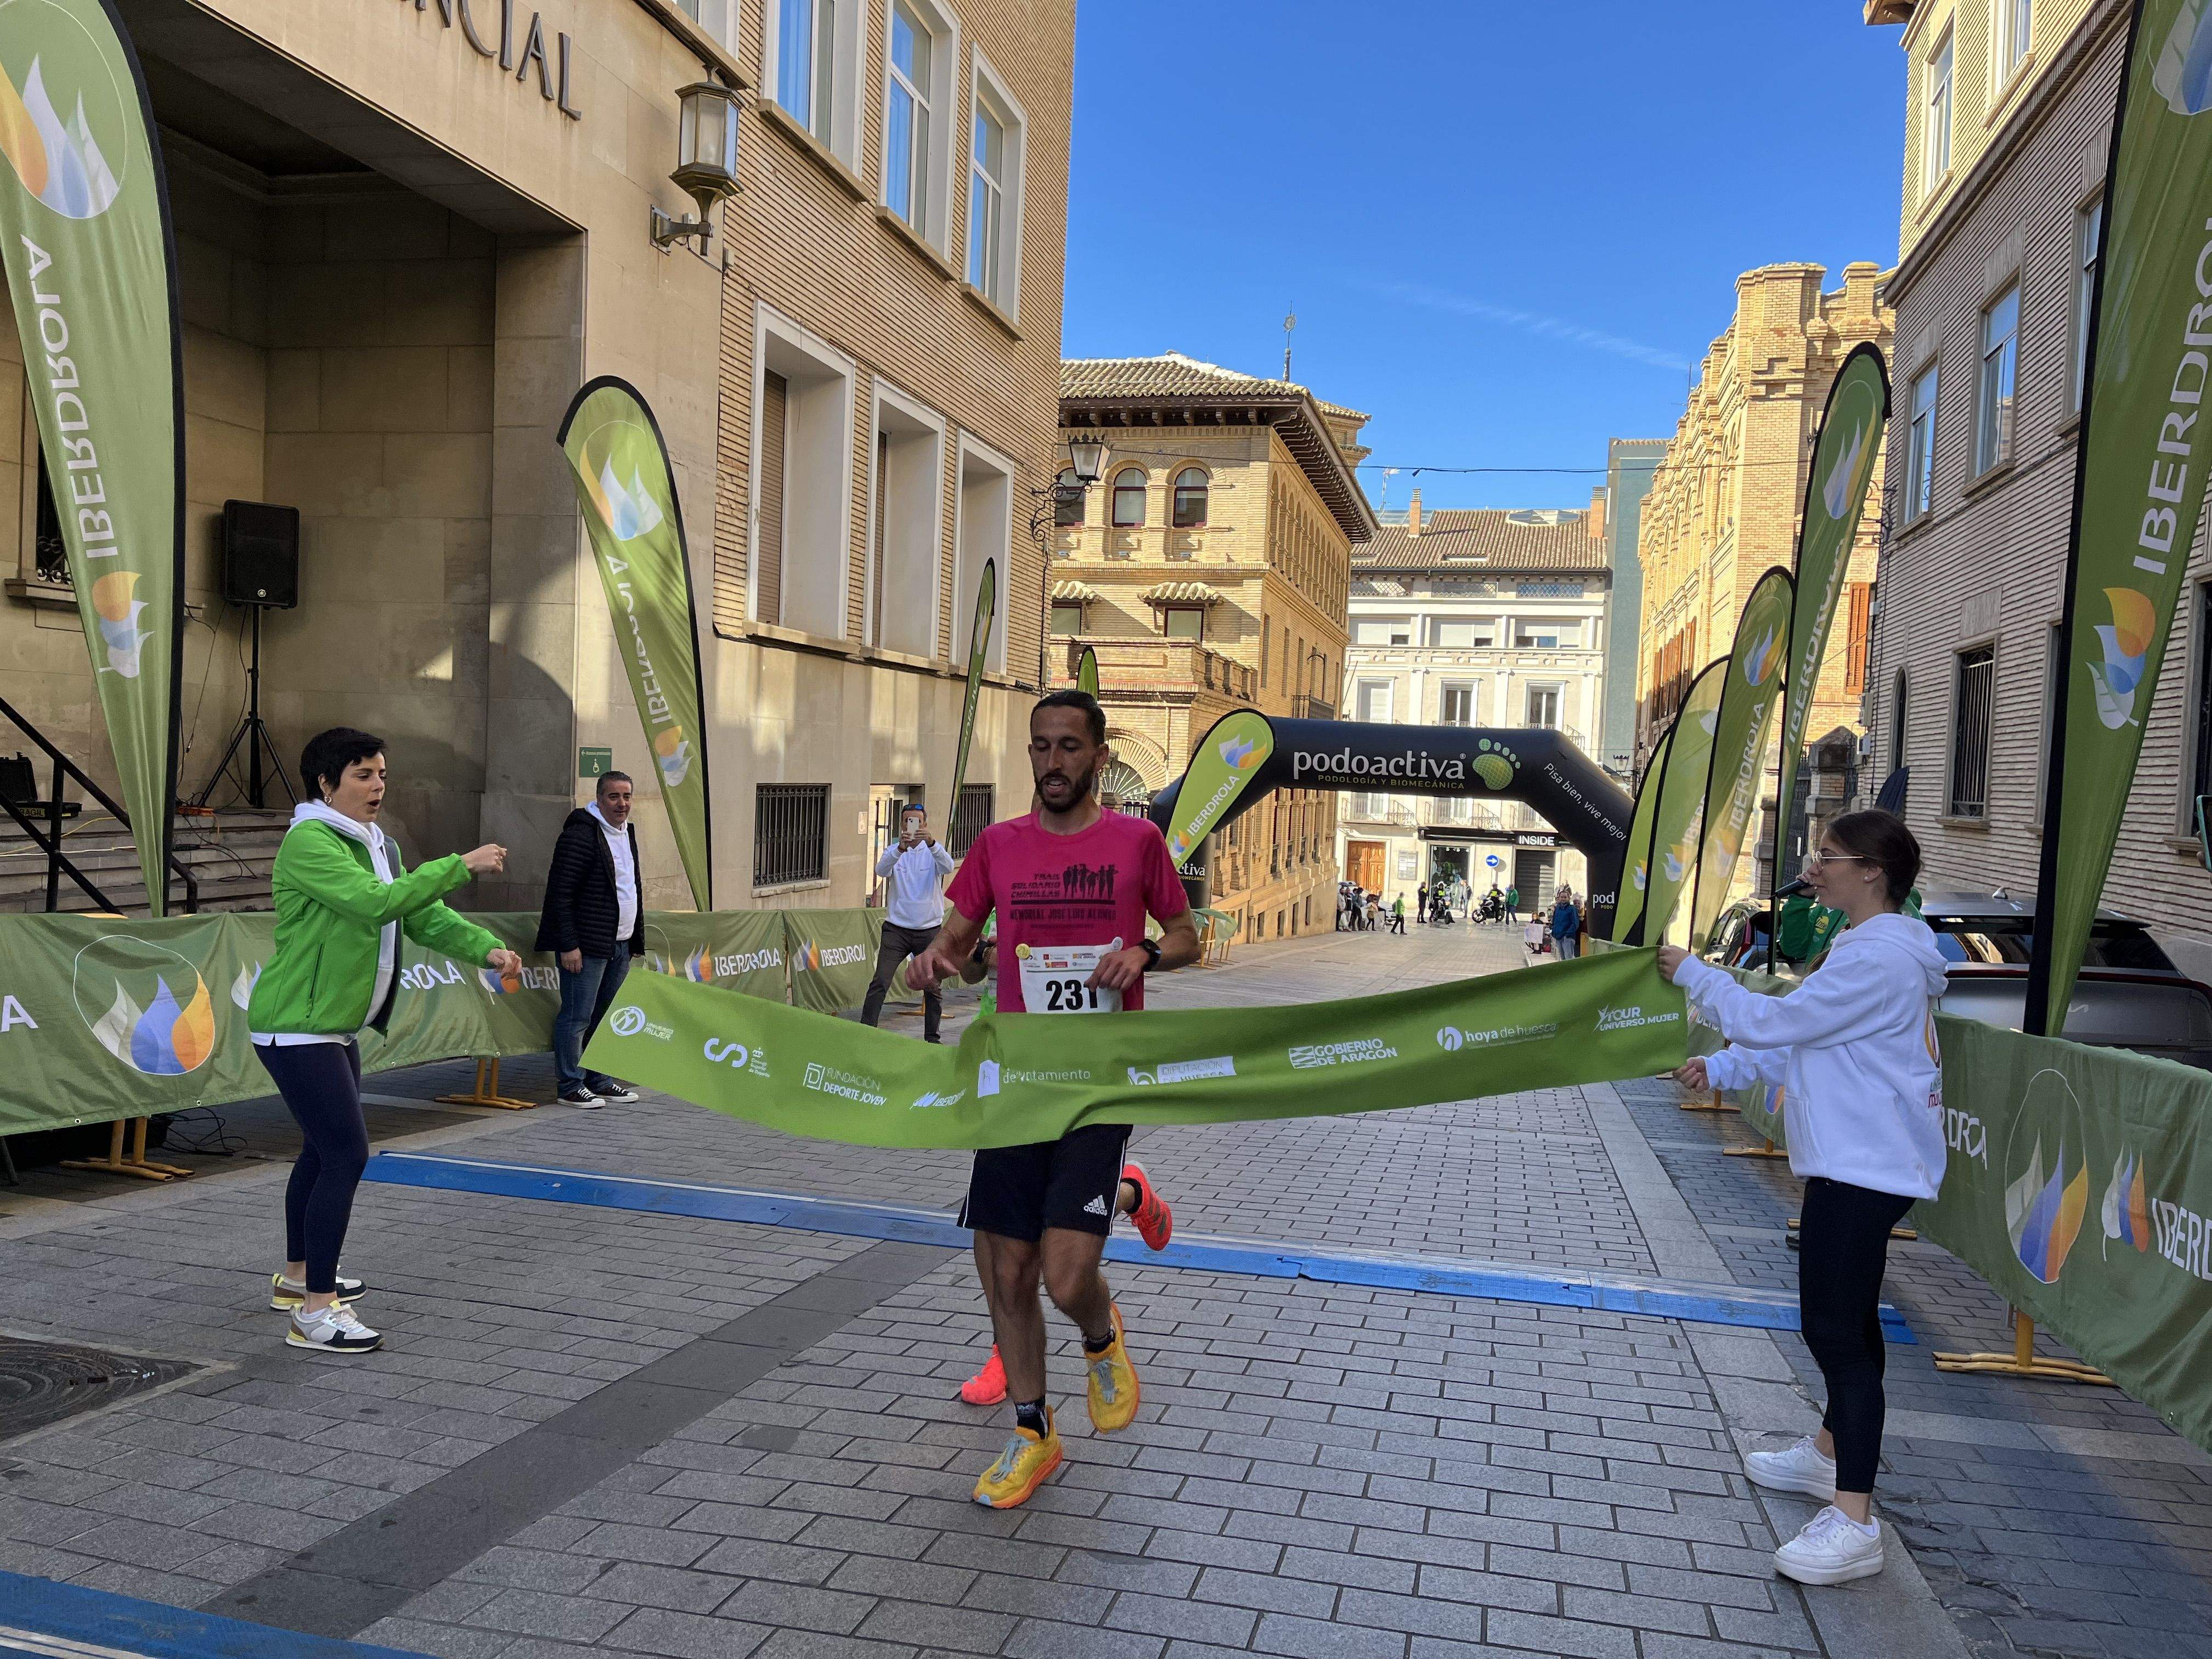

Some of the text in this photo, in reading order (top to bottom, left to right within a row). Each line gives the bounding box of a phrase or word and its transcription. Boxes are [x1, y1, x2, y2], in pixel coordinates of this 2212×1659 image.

[2133, 217, 2212, 574] IBERDRO
[1293, 747, 1465, 780] podoactiva
[1729, 702, 1764, 830] IBERDROLA
[1318, 774, 1377, 785] PODOLOGÍA
[1390, 779, 1465, 789] BIOMECÁNICA
[1544, 763, 1563, 784] Pisa
[1562, 780, 1582, 804] bien,
[1584, 800, 1601, 819] vive
[1187, 775, 1240, 836] IBERDROLA
[1519, 835, 1555, 846] INSIDE
[715, 948, 782, 977] IBERDROLA
[521, 966, 560, 990] IBER
[1046, 979, 1098, 1011] 231
[1465, 1029, 1498, 1042] hoya
[1500, 1026, 1515, 1038] de
[1516, 1023, 1557, 1036] huesca
[1600, 1013, 1680, 1031] UNIVERSO MUJER
[643, 1027, 671, 1041] MUJER
[1314, 1038, 1384, 1057] GOBIERNO
[1316, 1057, 1336, 1066] DE
[823, 1082, 887, 1105] DEPORTE JOVEN
[1084, 1205, 1108, 1216] adidas
